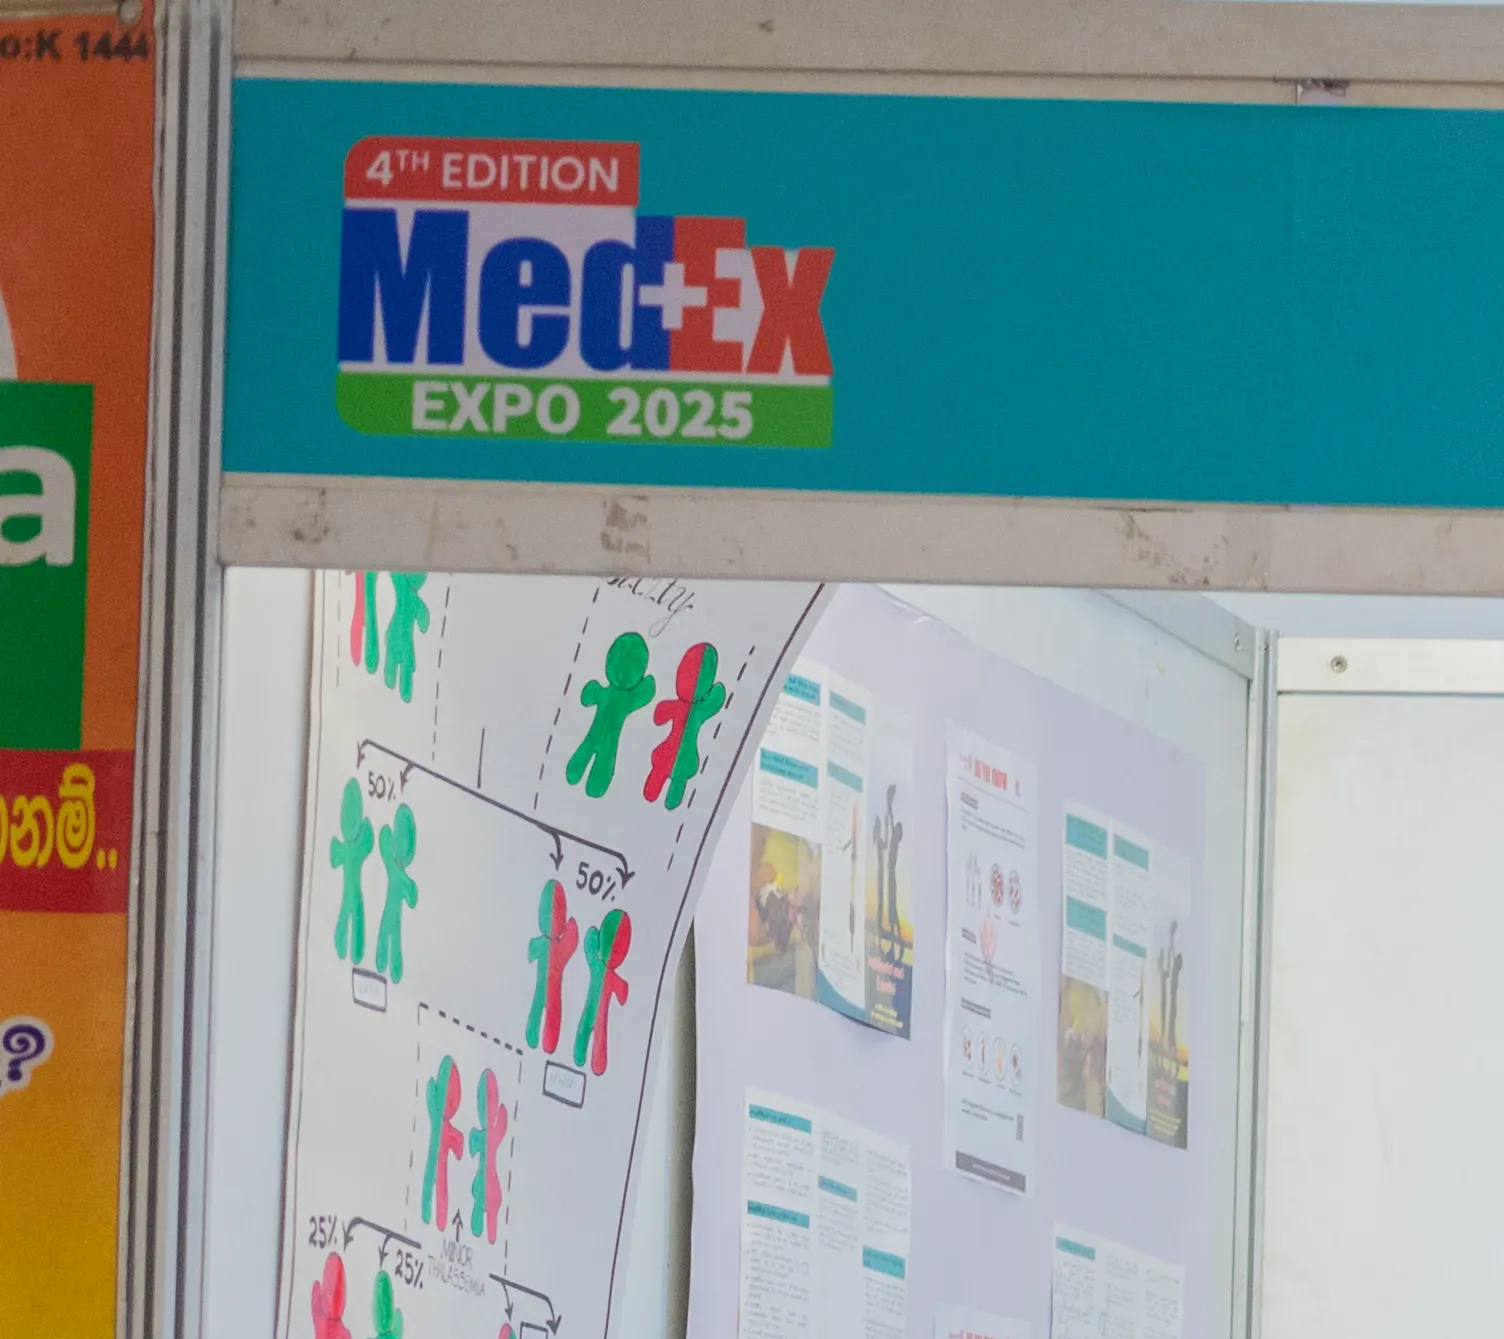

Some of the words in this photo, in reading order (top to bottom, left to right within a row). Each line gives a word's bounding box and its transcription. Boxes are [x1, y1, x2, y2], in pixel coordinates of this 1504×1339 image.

[441, 152, 620, 192] EDITION
[411, 380, 581, 436] EXPO
[606, 389, 755, 441] 2025
[366, 769, 397, 802] 50%
[575, 861, 618, 902] 50%
[308, 1215, 339, 1248] 25%
[393, 1248, 424, 1290] 25%
